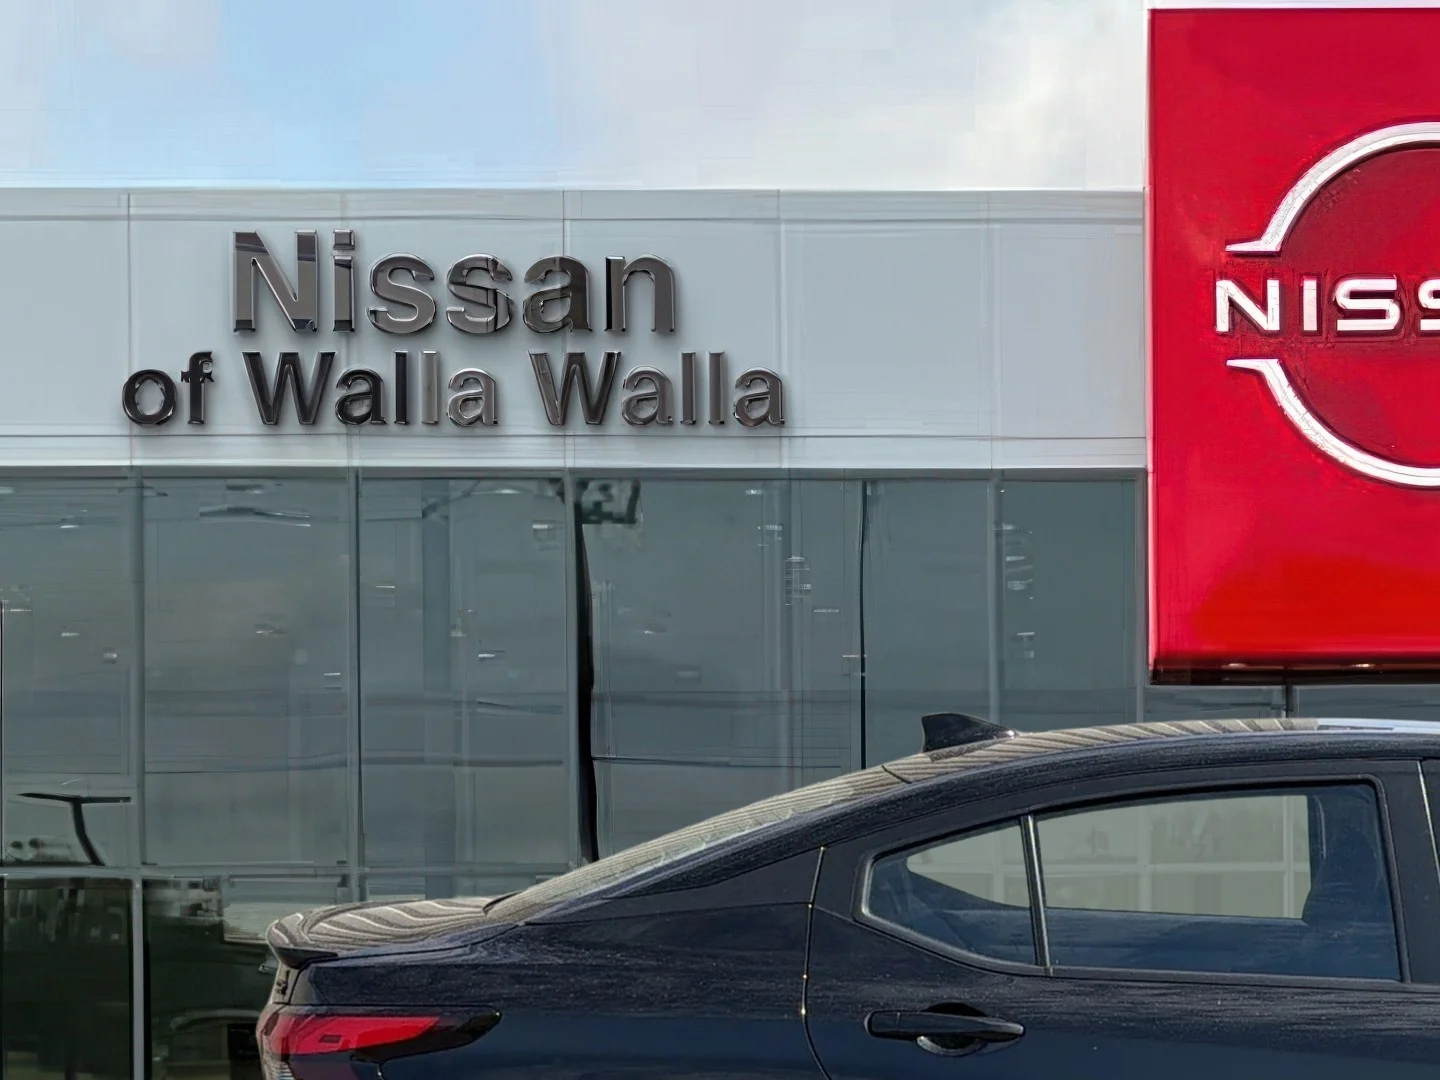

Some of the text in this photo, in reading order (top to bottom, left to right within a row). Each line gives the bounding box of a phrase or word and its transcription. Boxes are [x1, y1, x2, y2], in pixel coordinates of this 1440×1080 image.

[232, 228, 678, 333] Nissan
[120, 349, 786, 428] of Walla Walla
